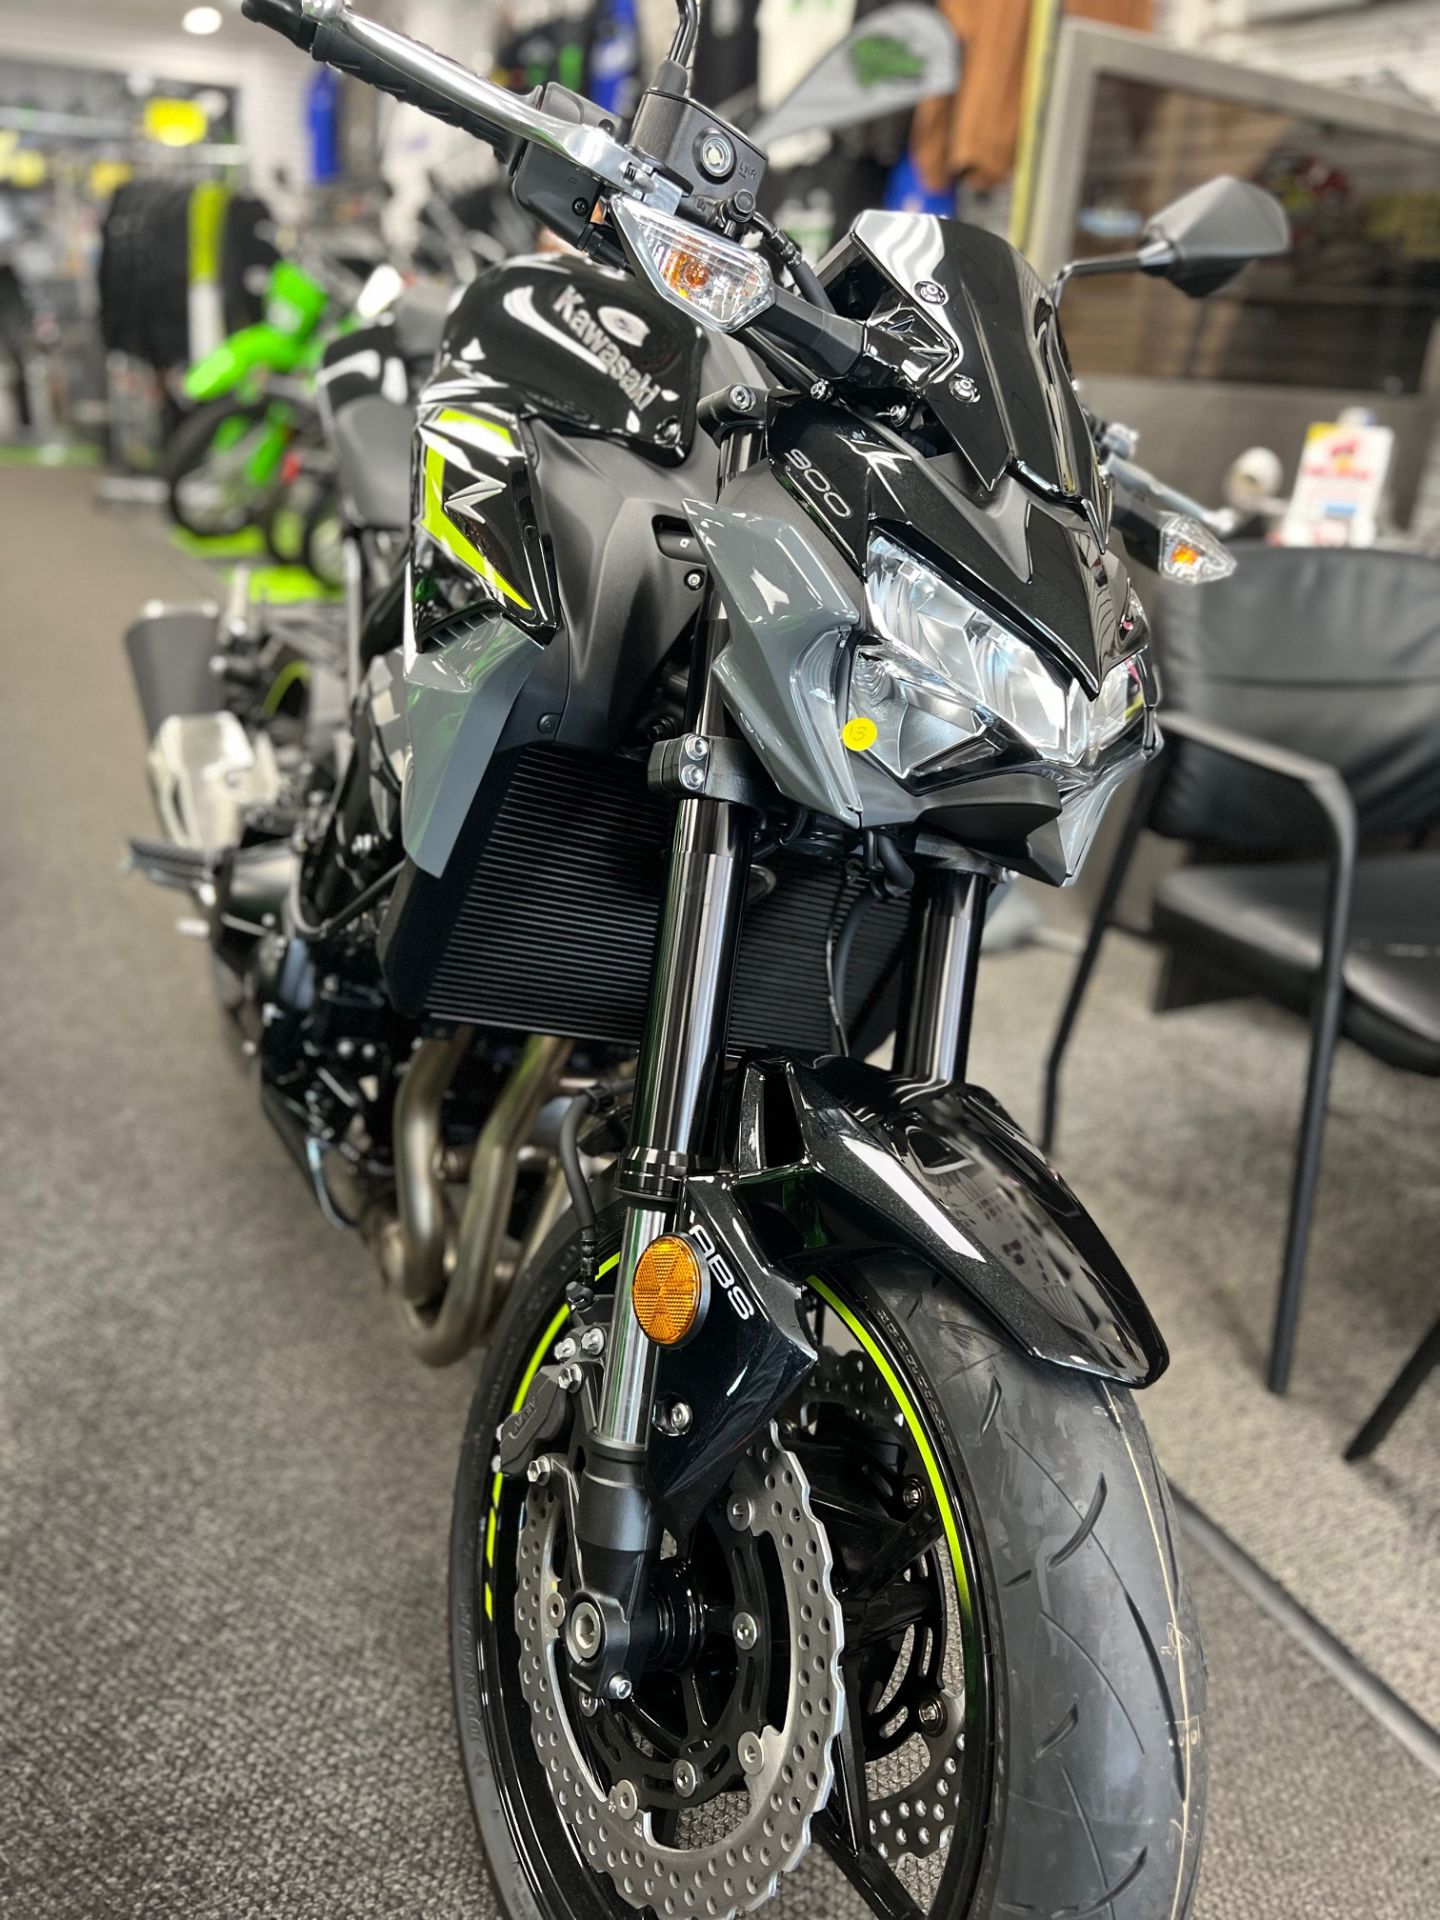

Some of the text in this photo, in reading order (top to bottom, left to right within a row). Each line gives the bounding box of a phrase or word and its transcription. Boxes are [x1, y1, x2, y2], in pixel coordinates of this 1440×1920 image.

[552, 284, 661, 411] Kawasaki
[784, 448, 852, 518] 900
[848, 725, 867, 741] 13
[688, 1224, 755, 1320] ABS
